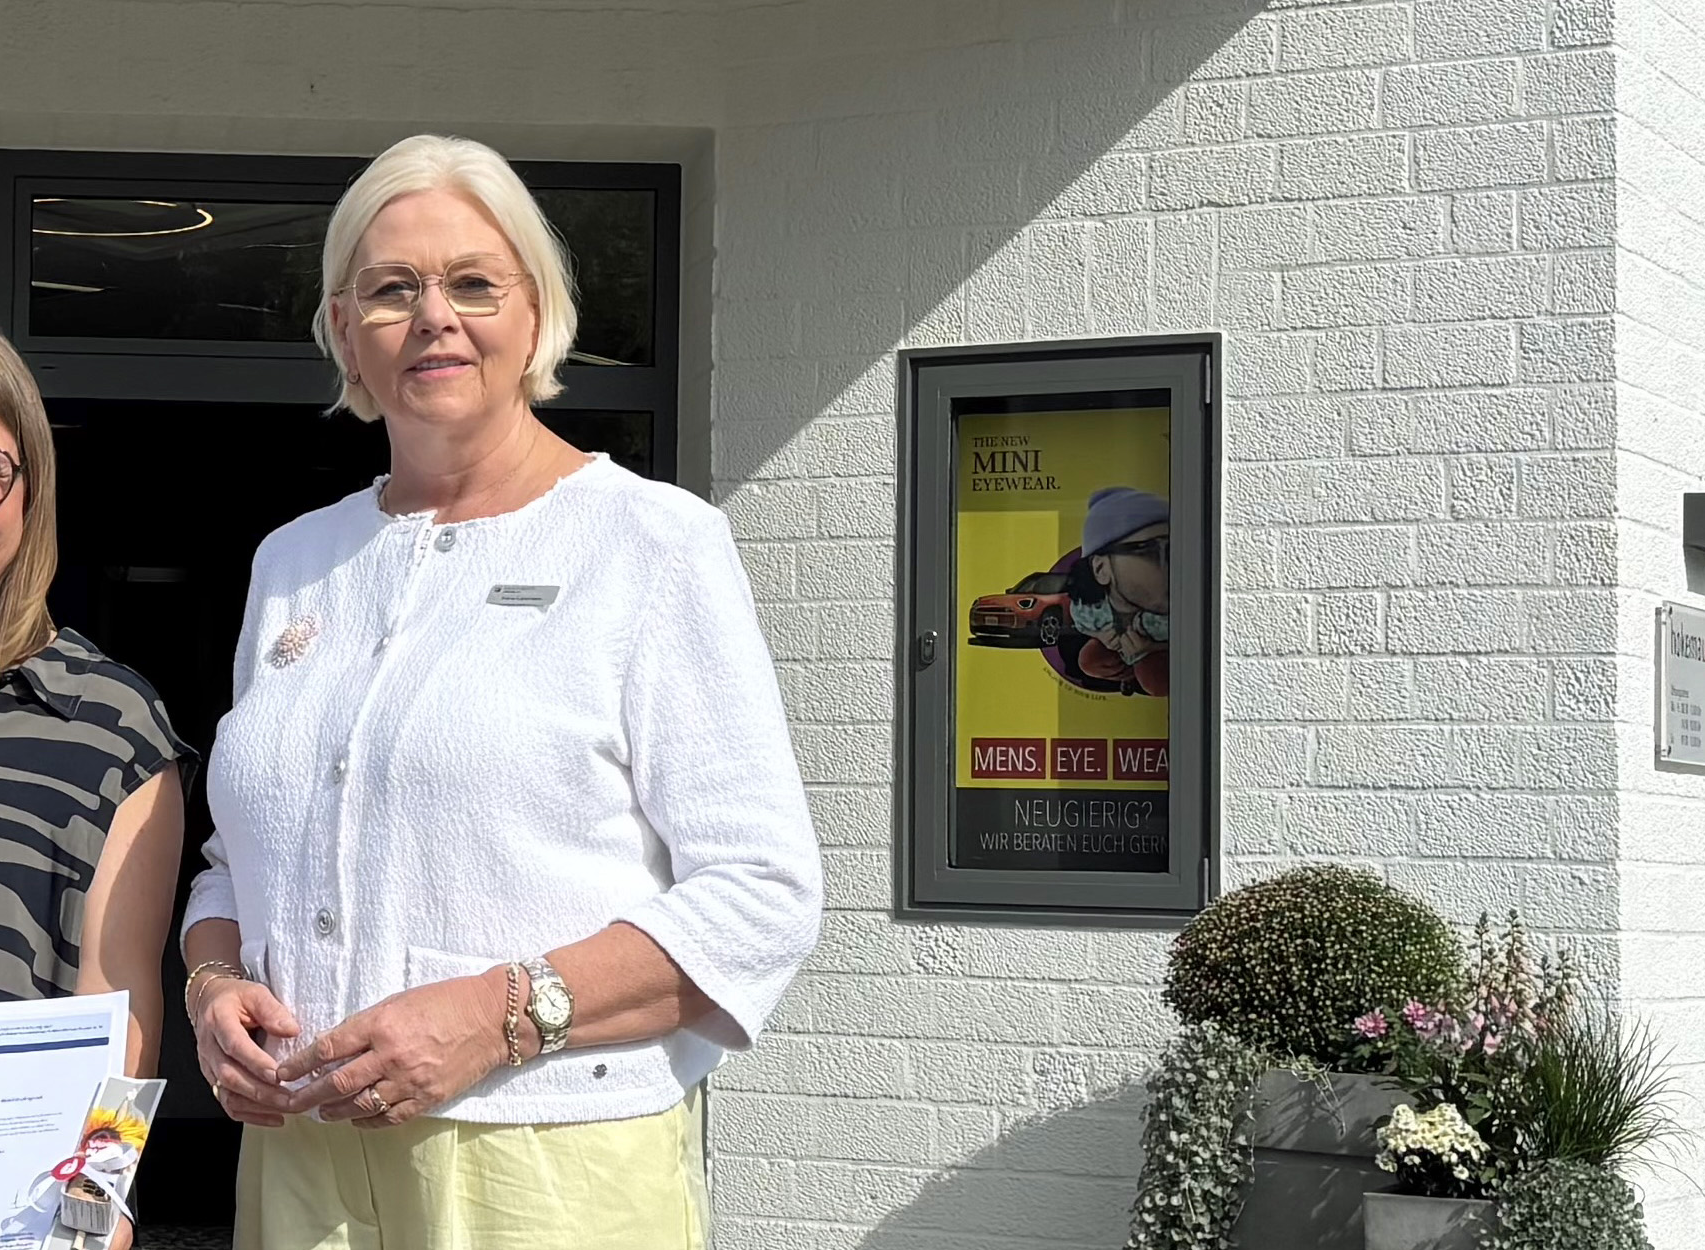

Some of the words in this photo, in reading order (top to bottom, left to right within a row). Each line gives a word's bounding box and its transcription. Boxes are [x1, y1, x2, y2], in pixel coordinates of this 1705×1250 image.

[973, 437, 998, 448] THE
[1000, 436, 1031, 447] NEW
[972, 450, 1042, 474] MINI
[972, 476, 1061, 491] EYEWEAR.
[974, 746, 1042, 772] MENS.
[1056, 747, 1101, 773] EYE.
[1014, 799, 1153, 829] NEUGIERIG?
[980, 832, 1009, 850] WIR
[1013, 832, 1077, 851] BERATEN
[1083, 834, 1125, 853] EUCH
